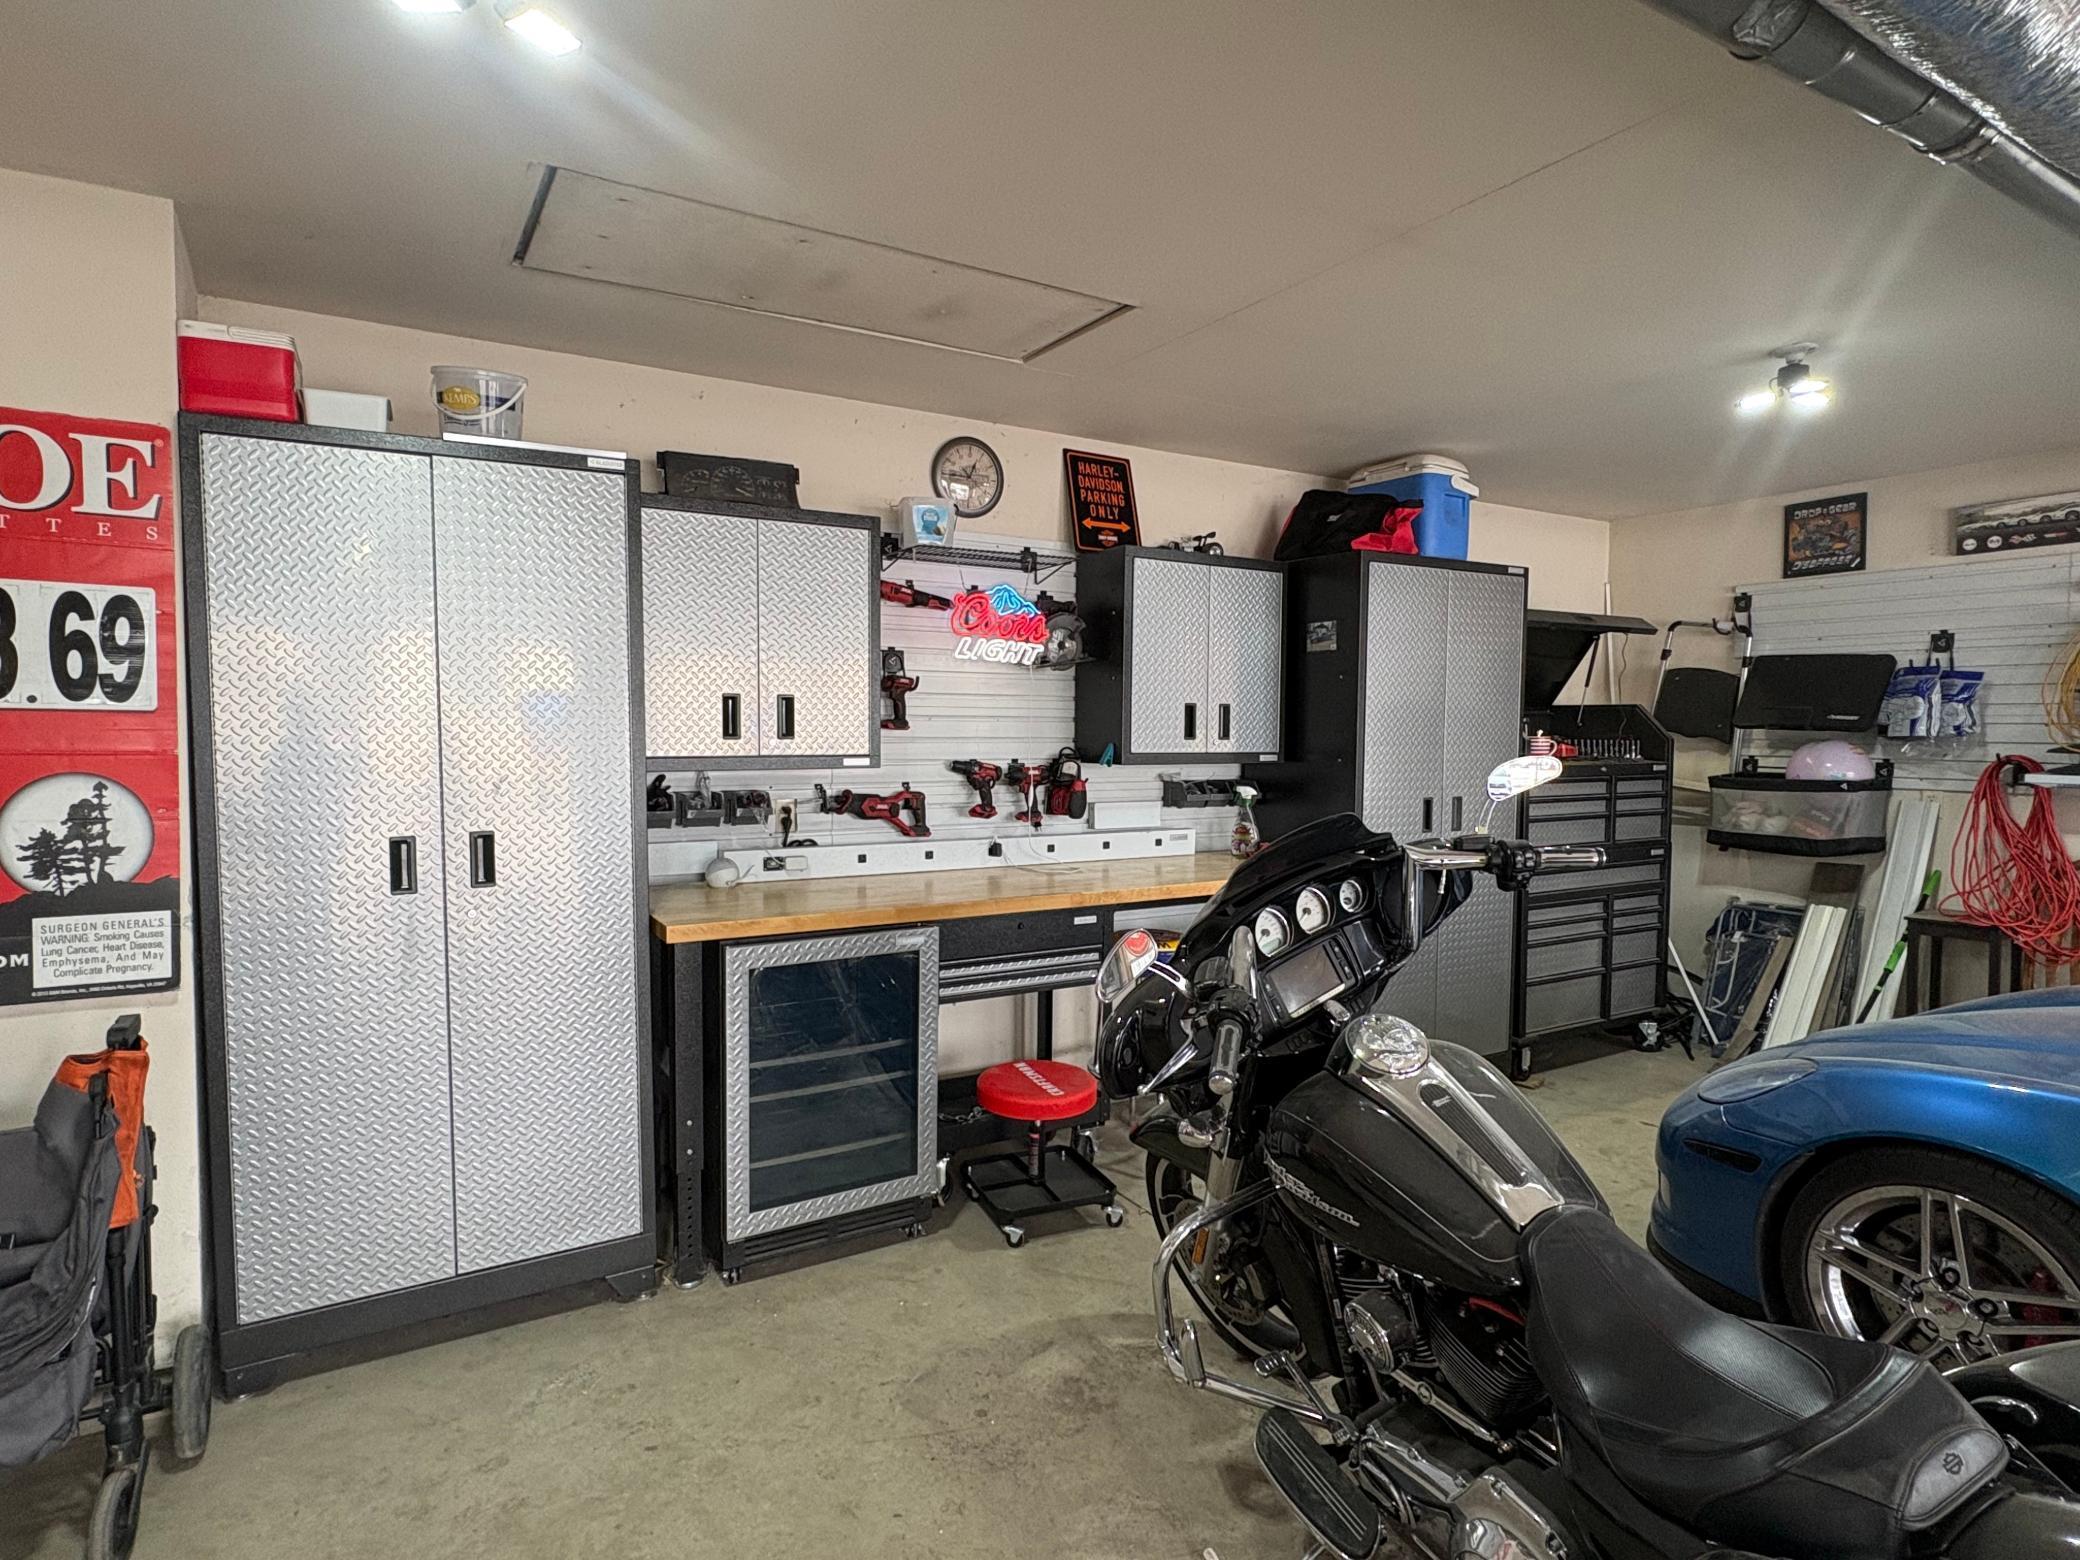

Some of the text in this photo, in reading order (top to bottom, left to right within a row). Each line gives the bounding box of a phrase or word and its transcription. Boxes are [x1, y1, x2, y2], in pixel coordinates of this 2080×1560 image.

[1078, 461, 1119, 478] HARLEY-
[1078, 475, 1124, 493] DAVIDSON
[1080, 489, 1125, 507] PARKING
[1090, 504, 1119, 519] ONLY
[1794, 507, 1821, 519] DROP
[951, 592, 1050, 644] Coors
[955, 637, 1044, 665] LIGHT
[41, 918, 164, 934] SURGEON GENERAL'S
[41, 930, 164, 945] WARNING: Smoking Causes
[41, 941, 164, 957] Lung Cancer, Heart Disease,
[42, 951, 164, 968] Emphysema, And May
[53, 963, 154, 978] Complicate Pregnancy.
